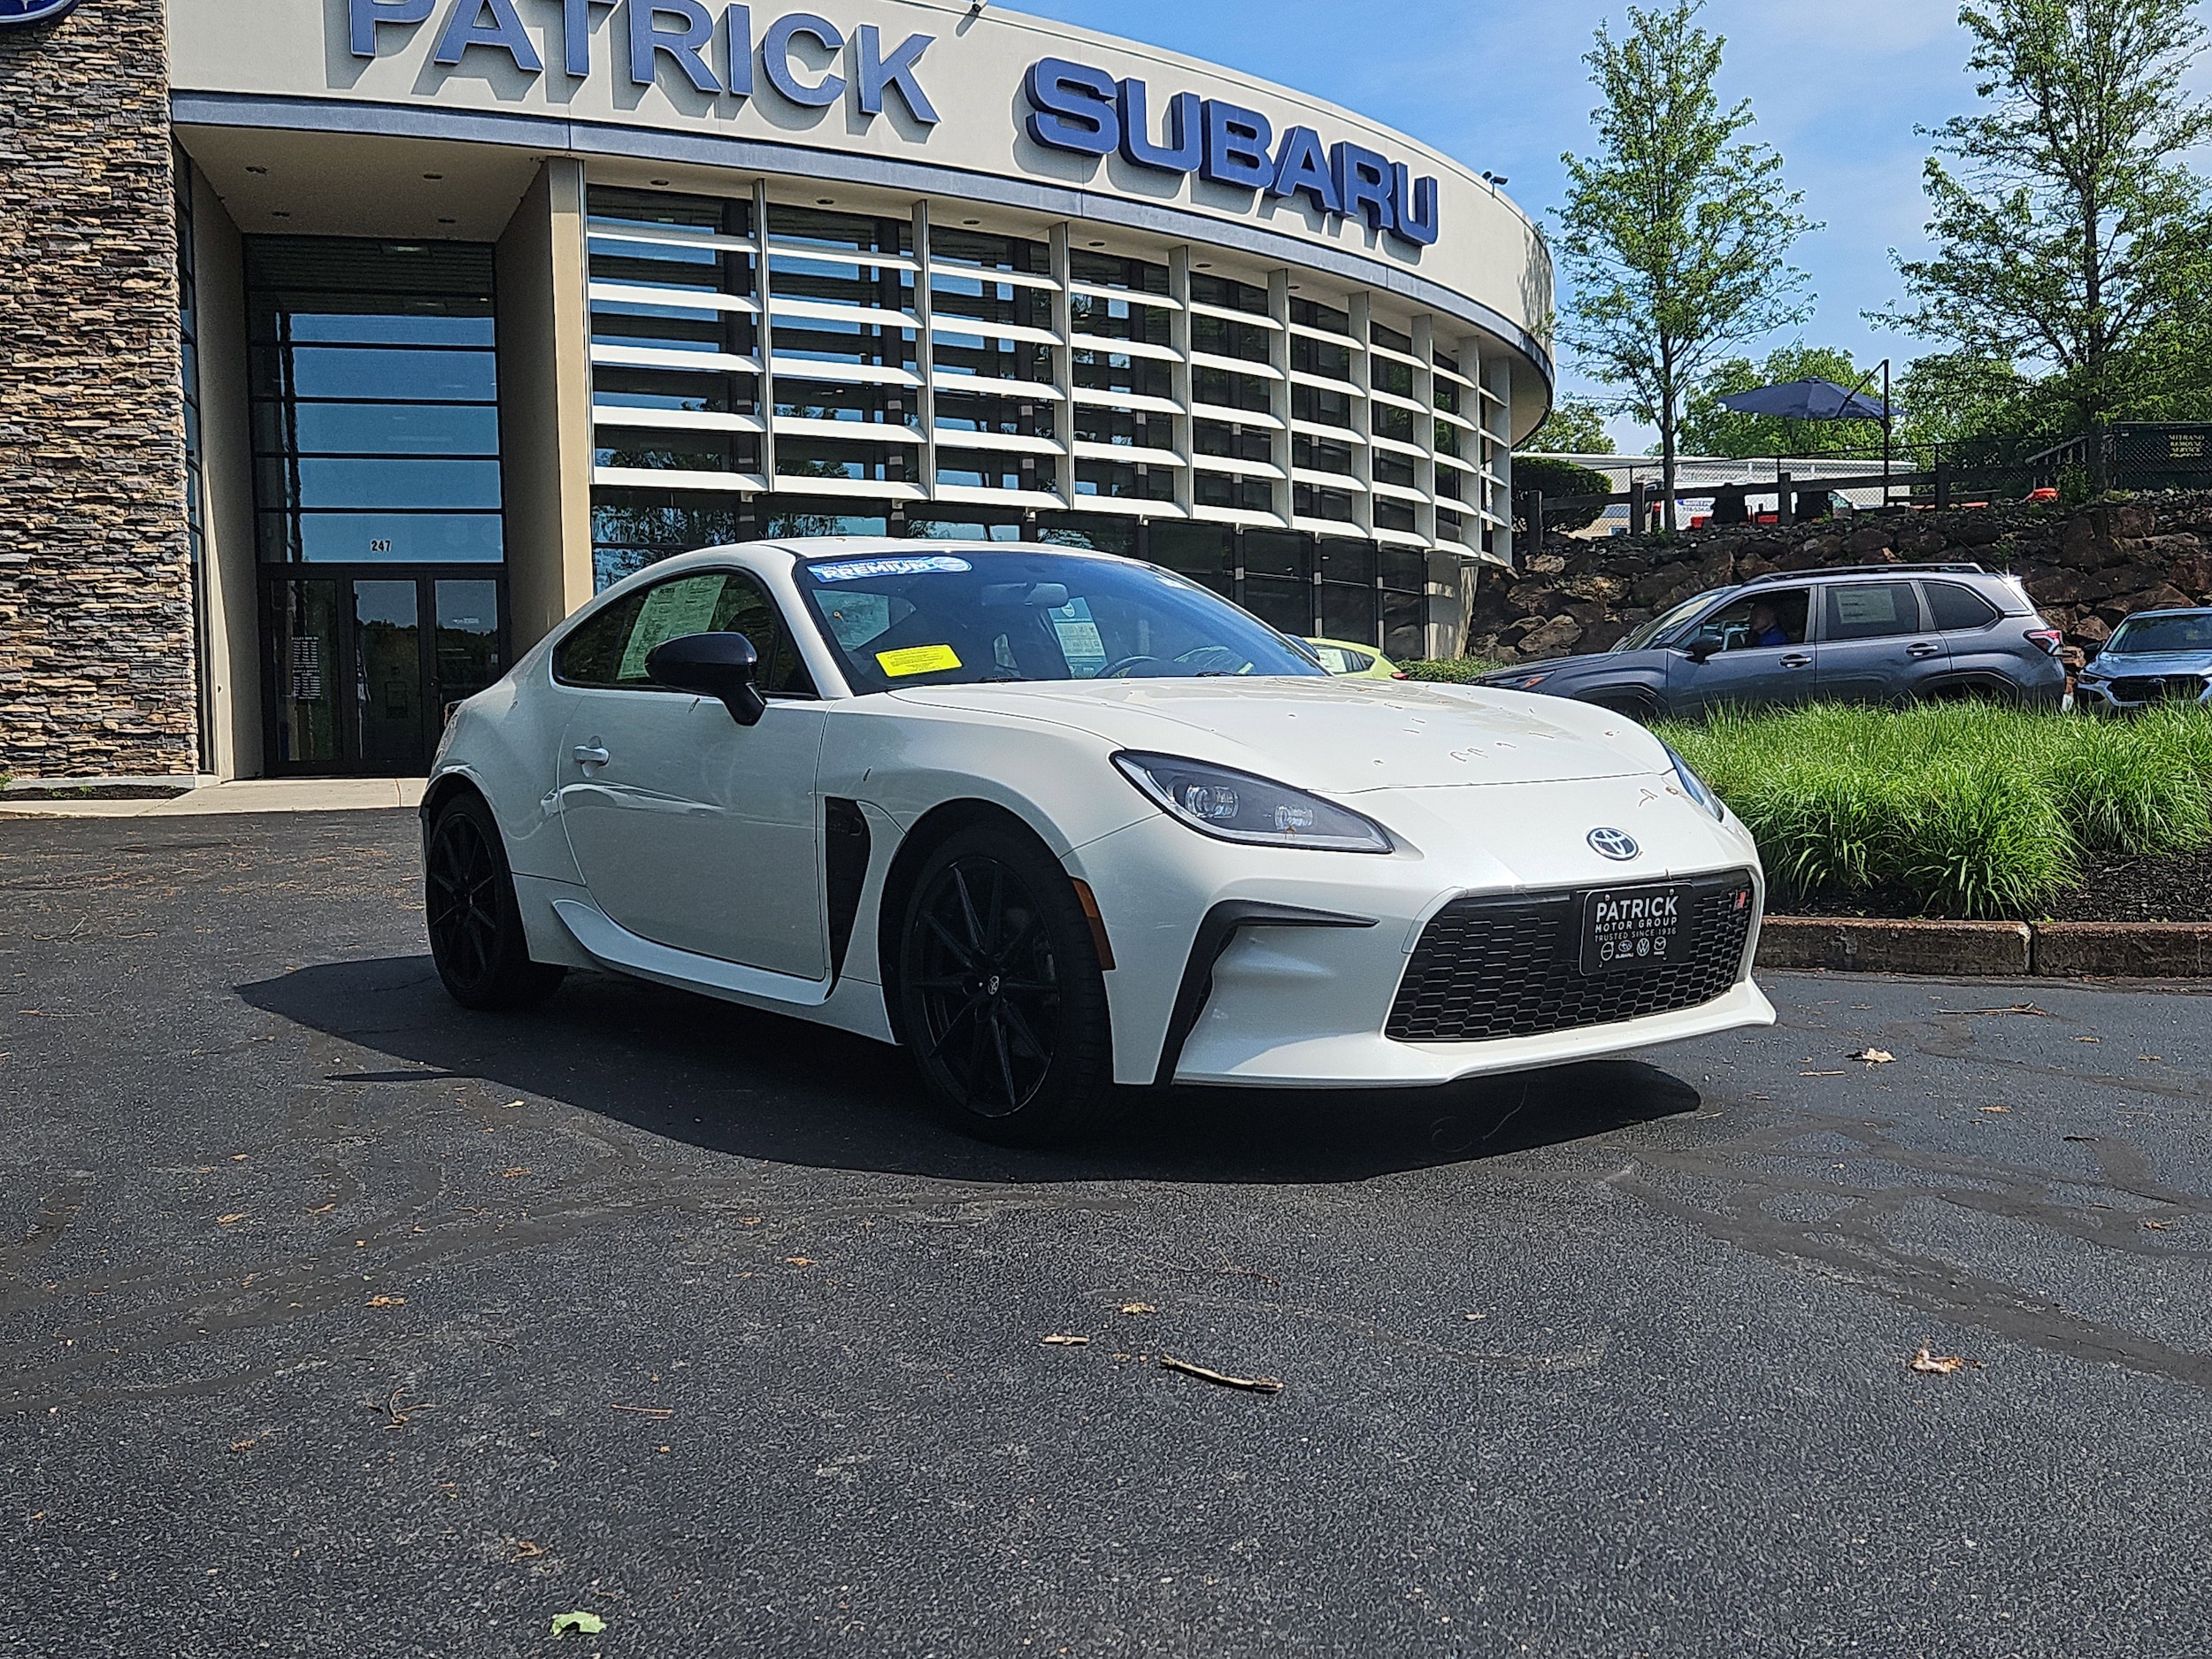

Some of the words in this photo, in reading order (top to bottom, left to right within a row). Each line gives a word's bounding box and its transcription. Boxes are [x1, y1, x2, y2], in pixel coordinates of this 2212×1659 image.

[350, 0, 941, 124] PATRICK
[1025, 57, 1438, 247] SUBARU
[371, 540, 392, 552] 247
[821, 559, 932, 579] PREMIUM
[1595, 895, 1679, 923] PATRICK
[1594, 920, 1632, 933] MOTOR
[1638, 916, 1678, 928] GROUP
[1594, 932, 1629, 942] TRUSTED
[1631, 928, 1655, 938] SINCE
[1657, 926, 1677, 935] 1936
